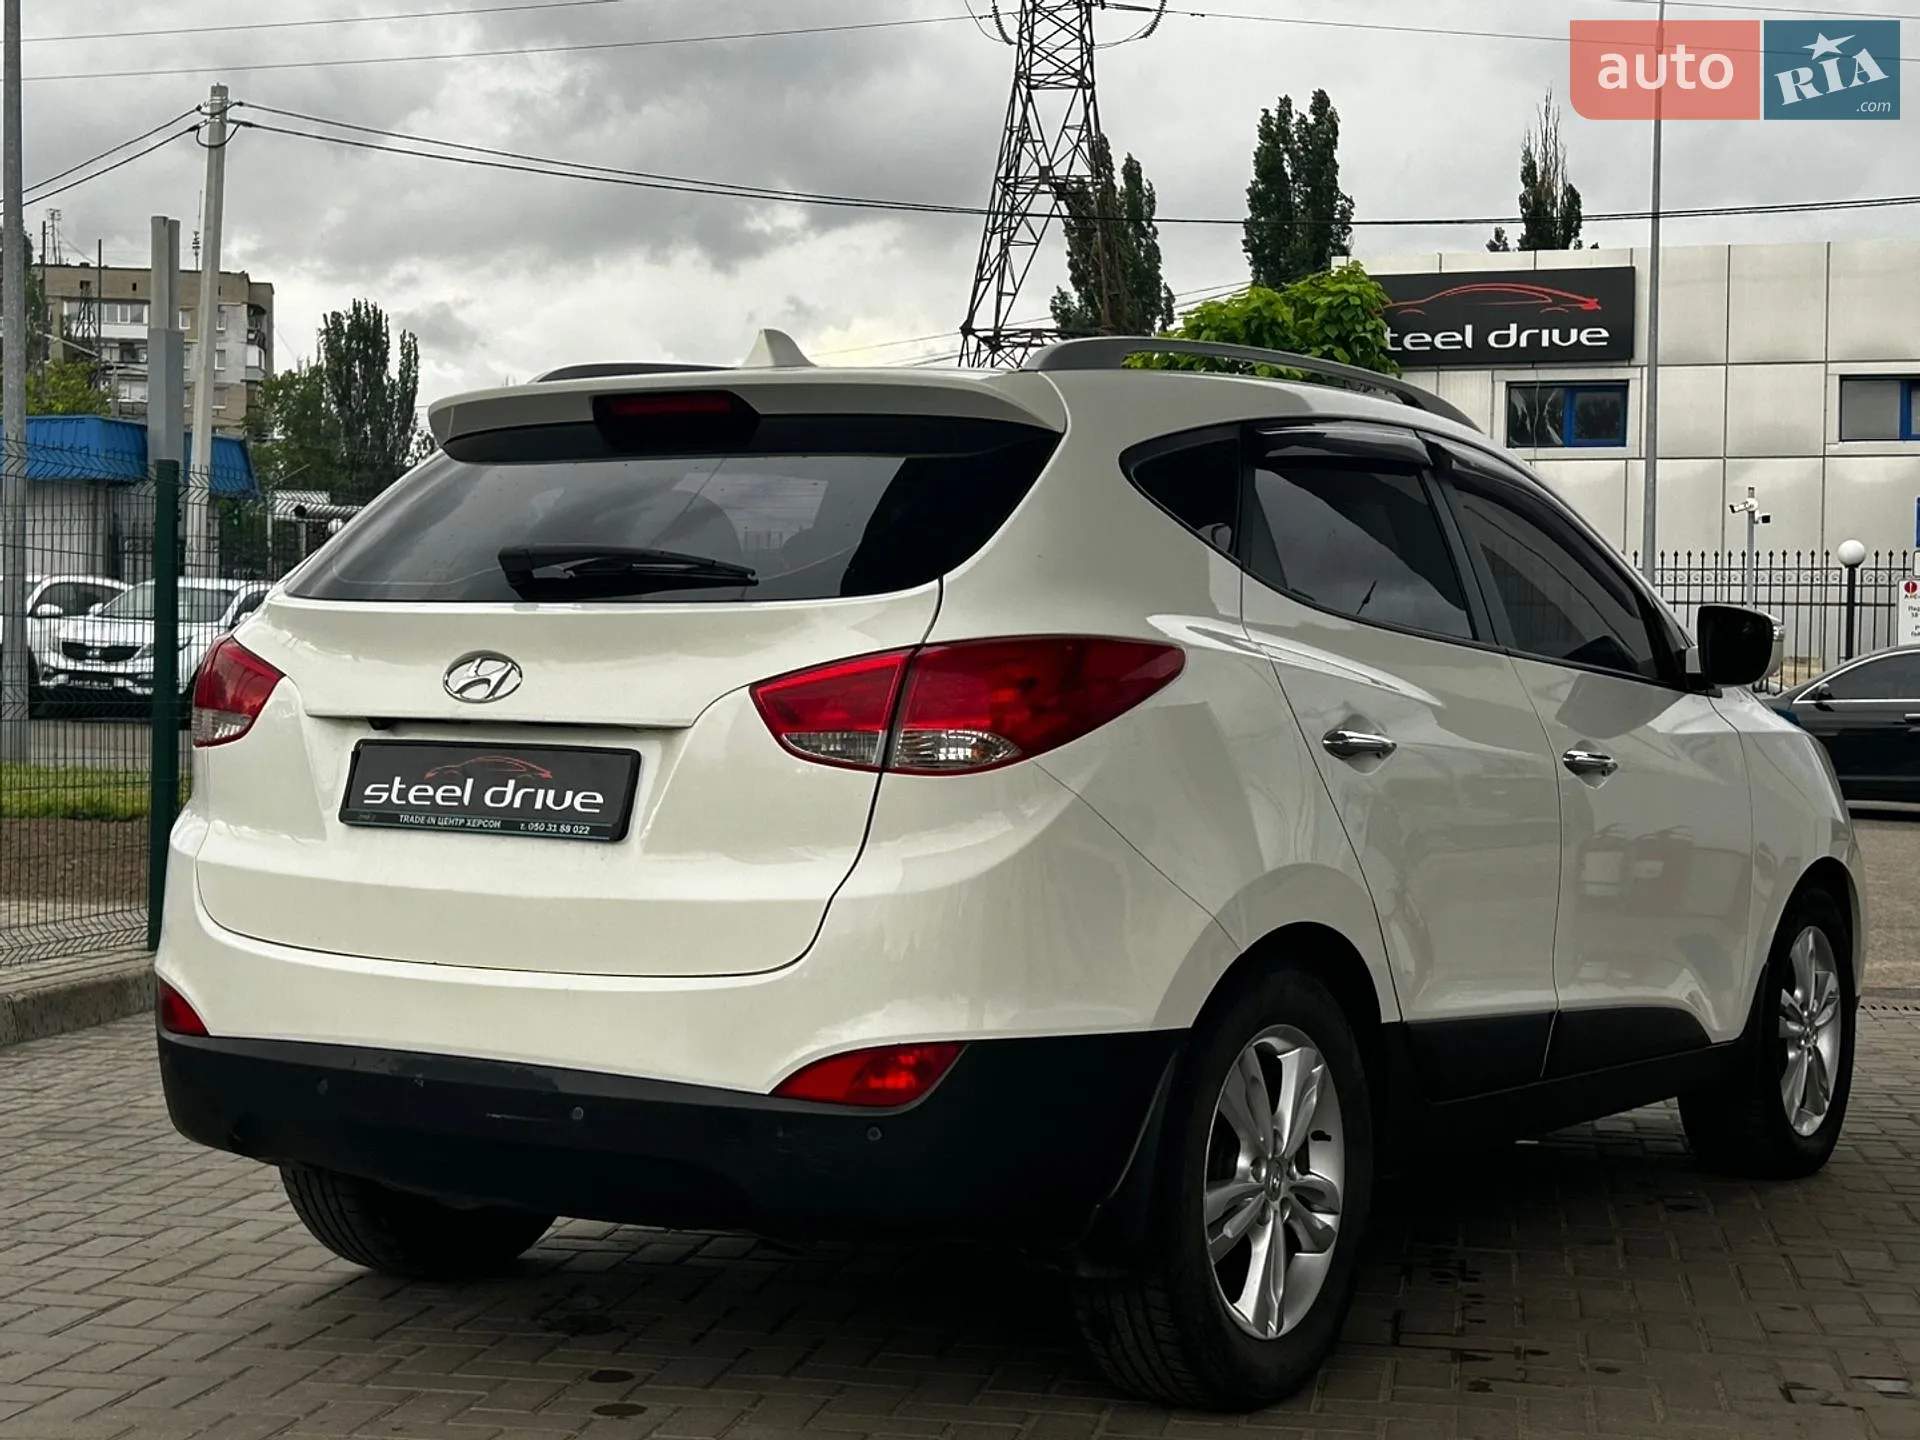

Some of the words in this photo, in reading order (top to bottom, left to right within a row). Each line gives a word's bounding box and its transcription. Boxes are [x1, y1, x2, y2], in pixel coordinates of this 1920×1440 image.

[1386, 324, 1473, 351] teel
[1486, 323, 1610, 349] drive
[363, 776, 475, 807] steel
[484, 779, 604, 814] drive
[399, 814, 426, 825] TRADE
[426, 816, 436, 826] IN
[437, 816, 465, 828] ЦЕНТР
[466, 818, 501, 829] ХЕРСОН
[527, 822, 546, 832] 050
